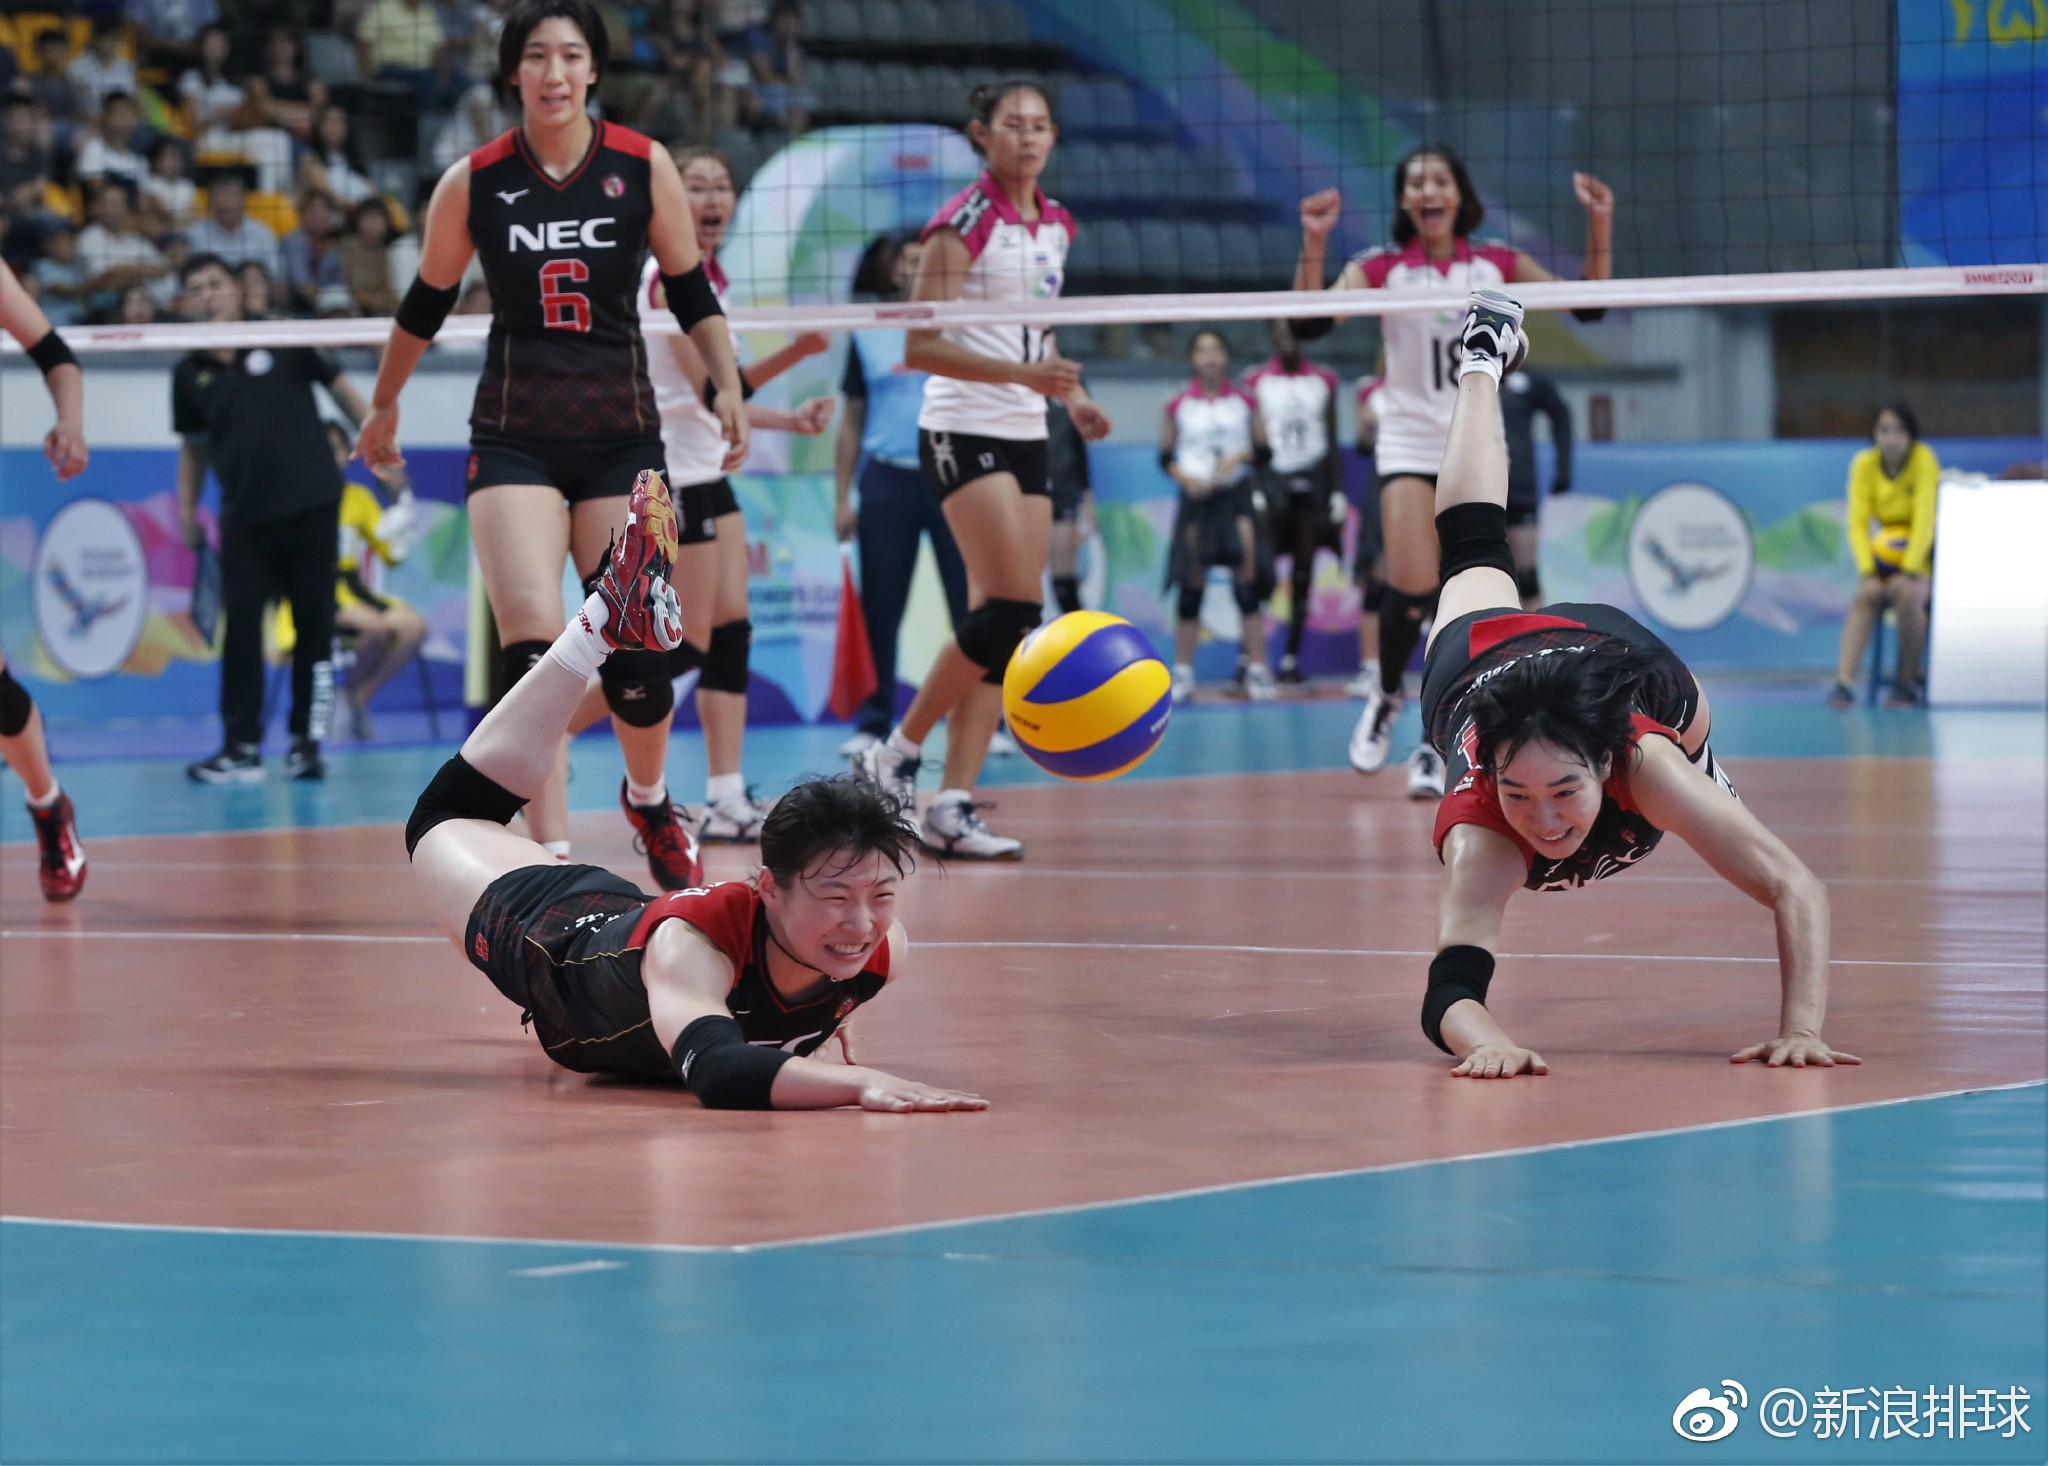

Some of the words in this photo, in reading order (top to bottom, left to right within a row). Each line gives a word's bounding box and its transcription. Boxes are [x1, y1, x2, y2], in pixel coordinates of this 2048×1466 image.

[508, 216, 617, 252] NEC
[539, 258, 592, 332] 6
[578, 607, 594, 635] NEC
